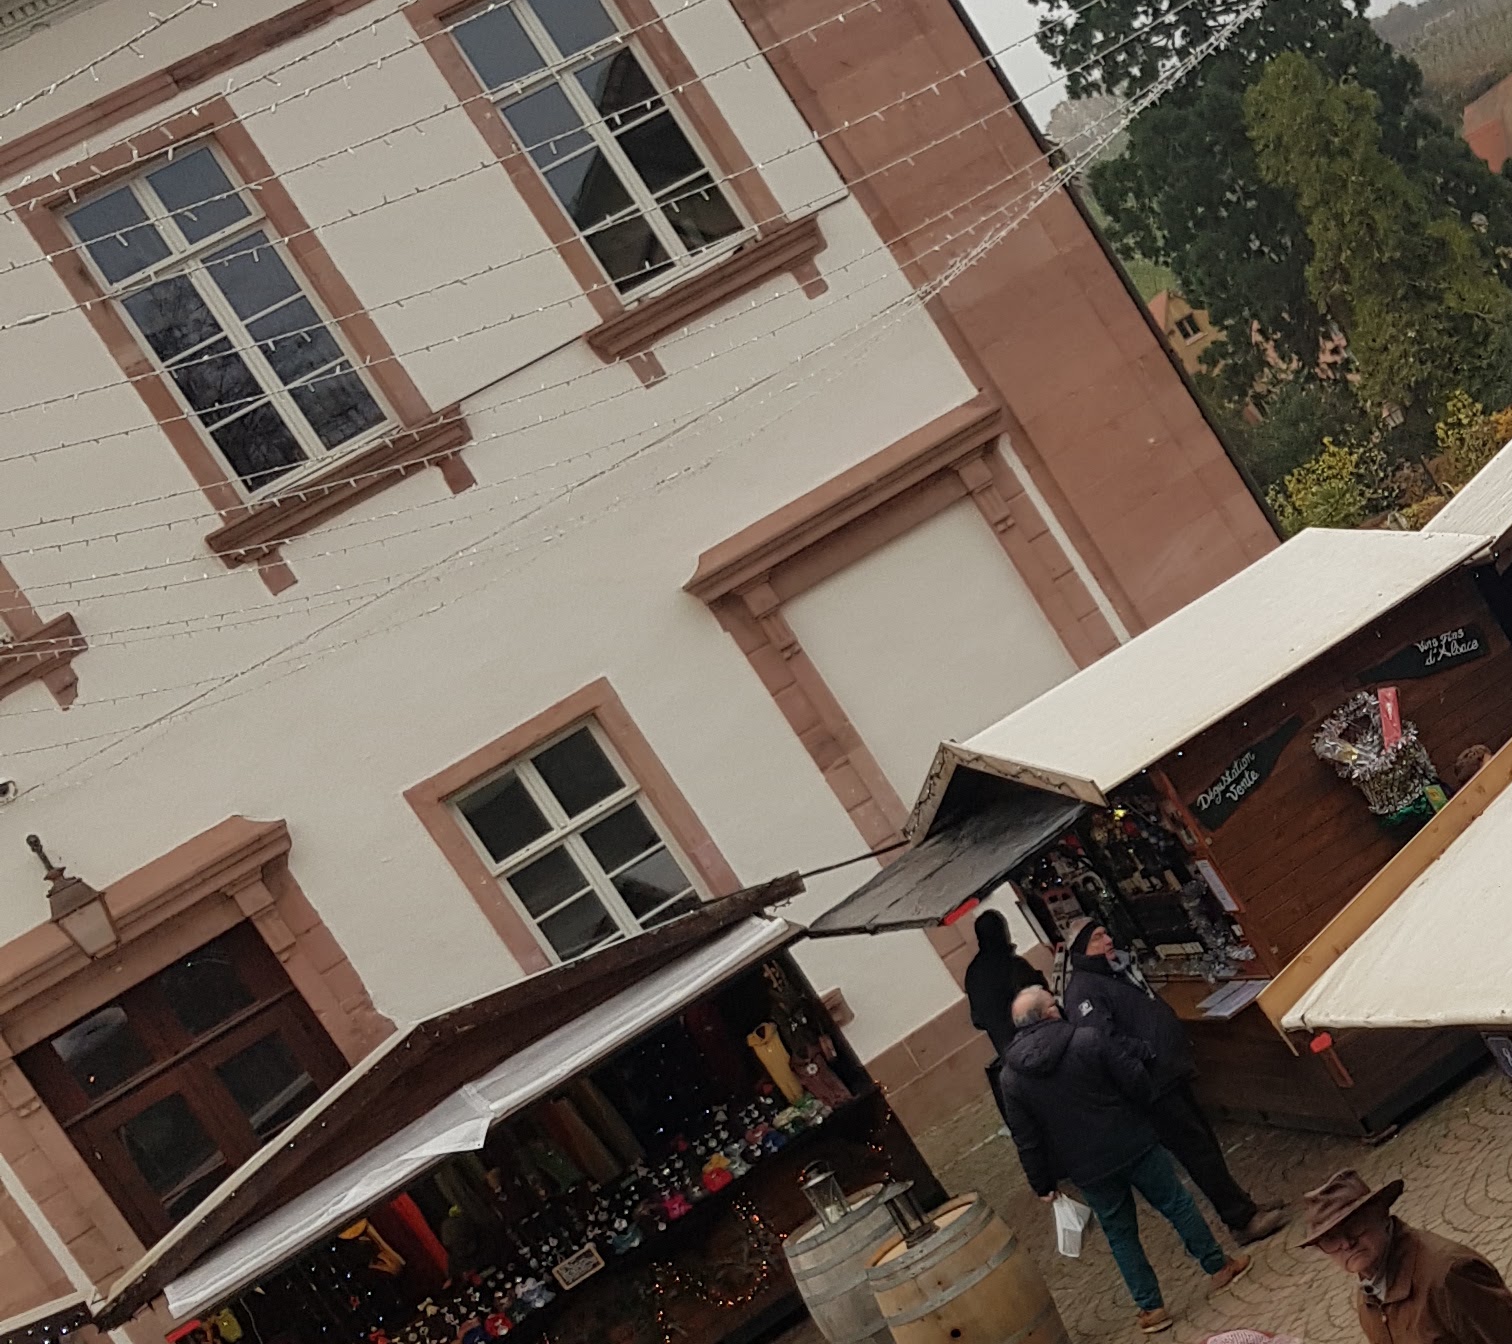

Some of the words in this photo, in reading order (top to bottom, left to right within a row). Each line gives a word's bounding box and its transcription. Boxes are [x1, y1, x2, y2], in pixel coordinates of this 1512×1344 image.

[1424, 639, 1479, 666] d'Alsace
[1440, 628, 1465, 651] Fins
[1196, 752, 1256, 811] Dégustation
[1225, 770, 1260, 801] Vente
